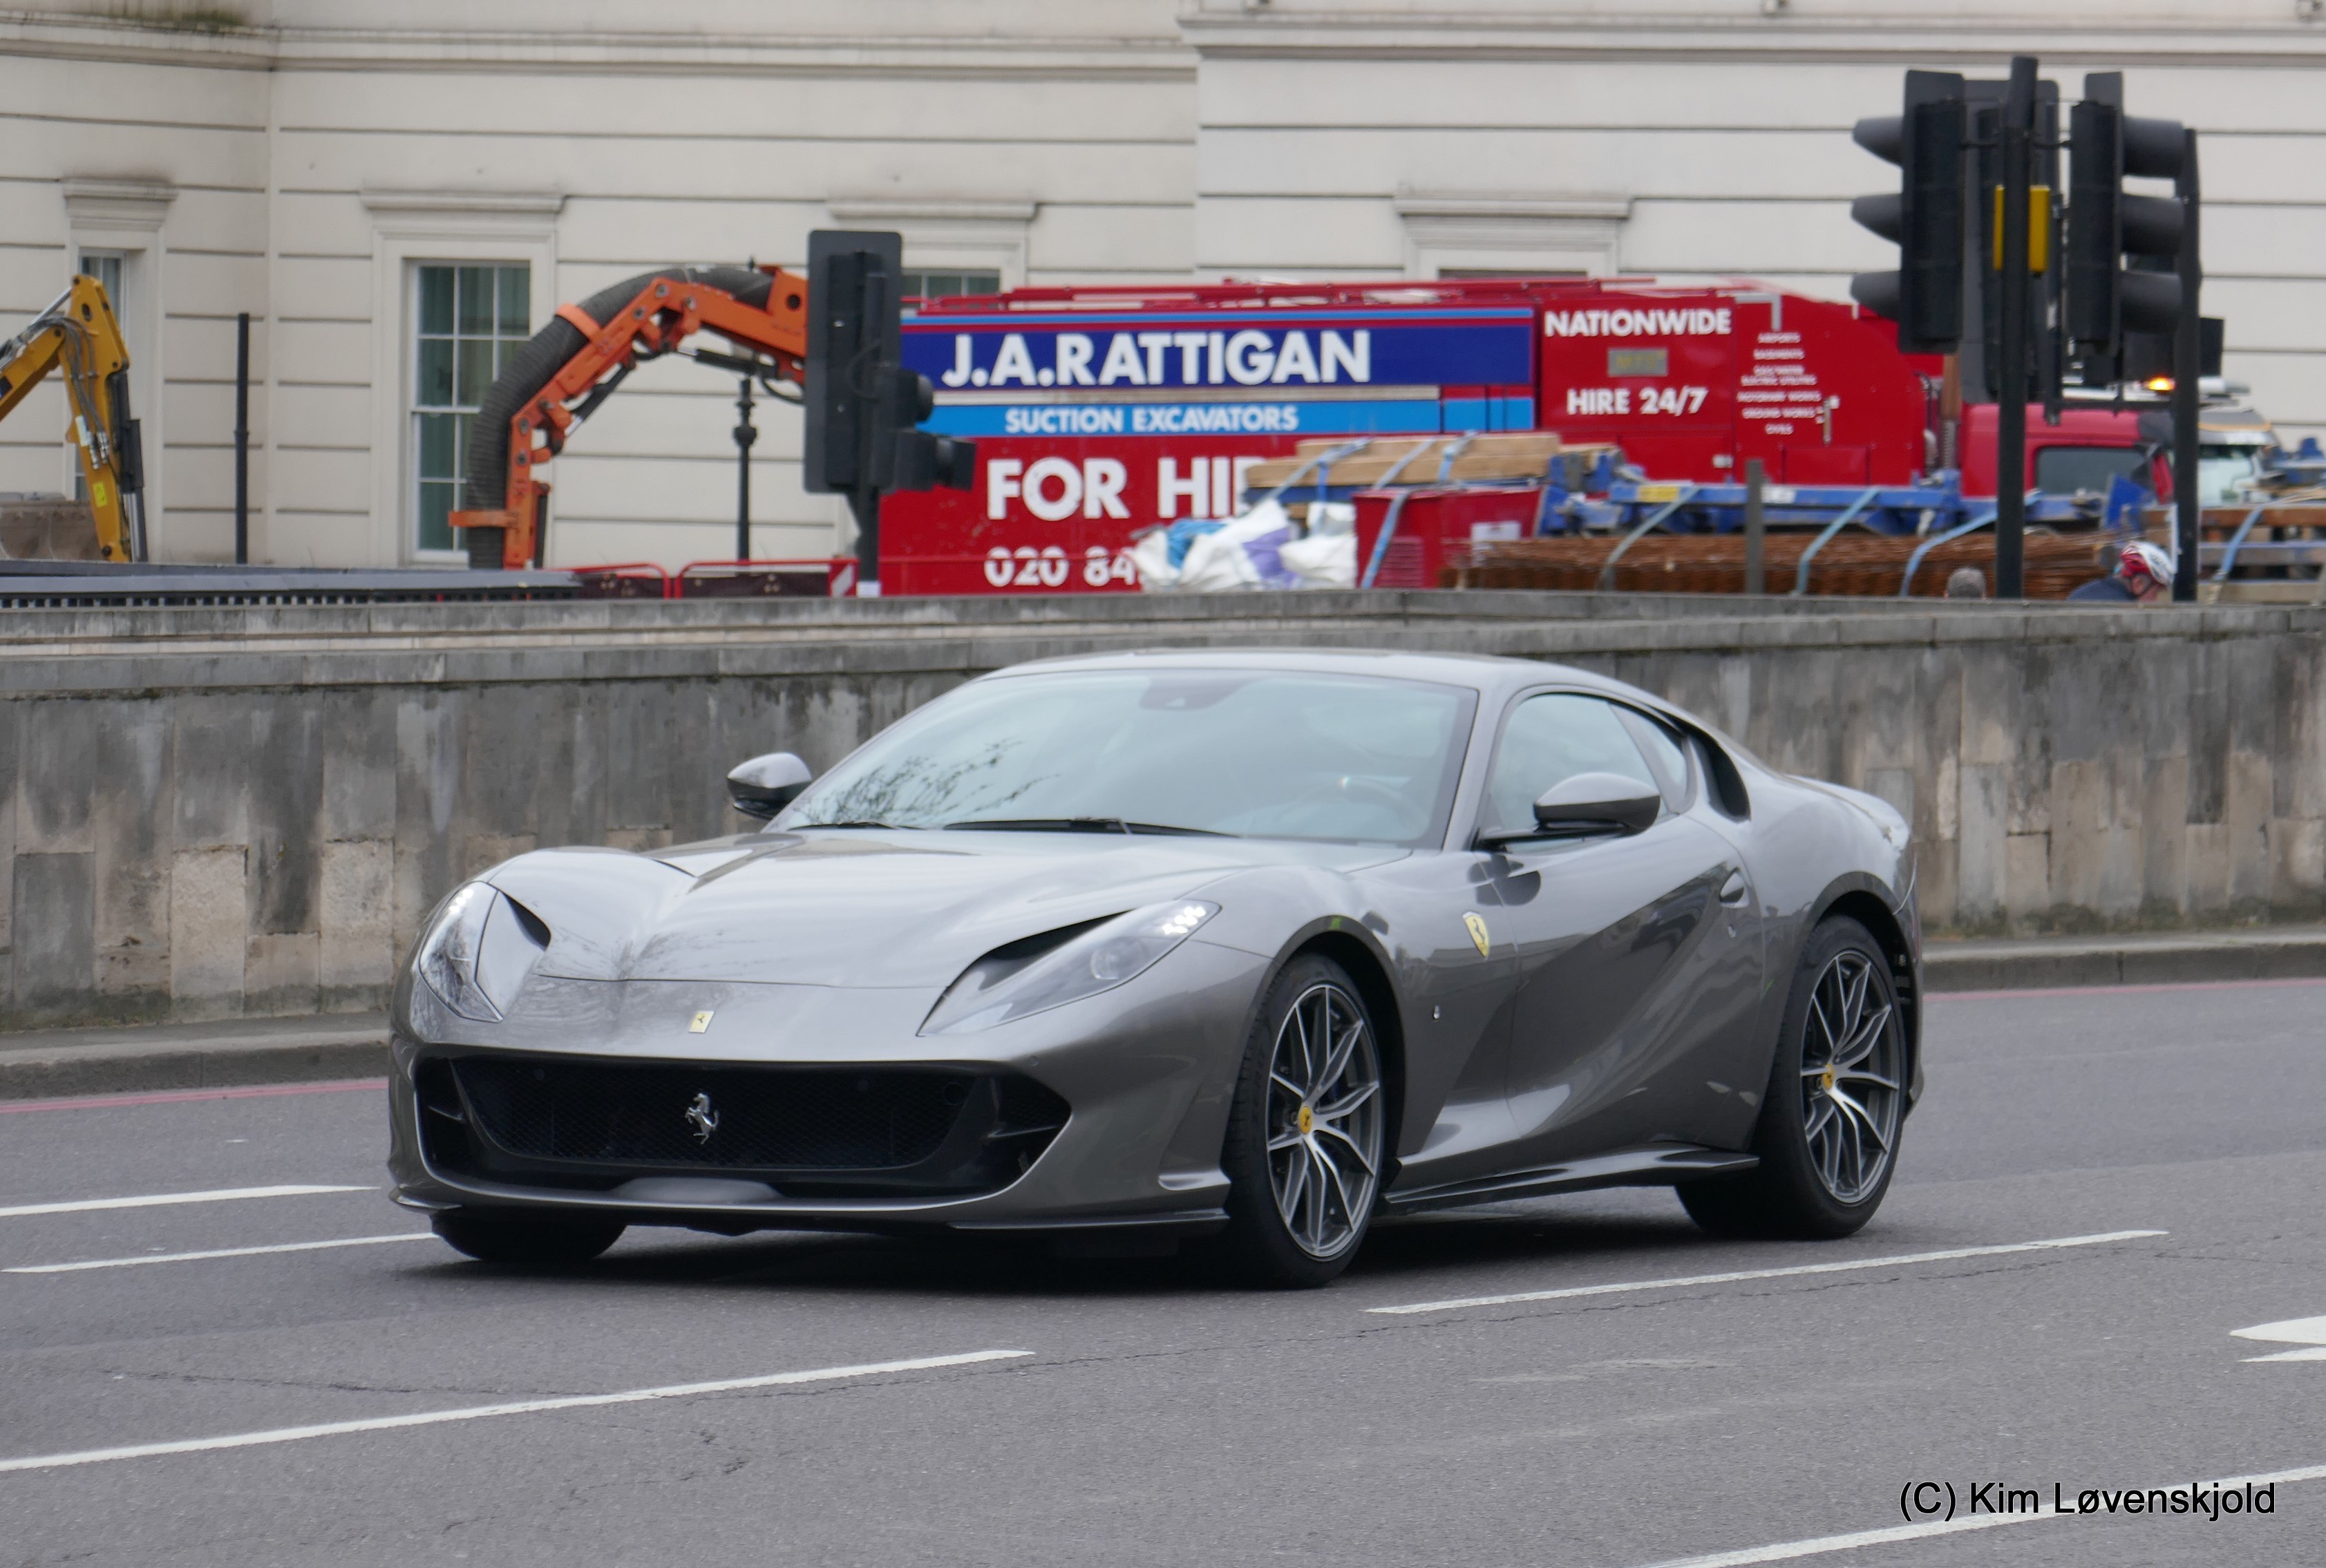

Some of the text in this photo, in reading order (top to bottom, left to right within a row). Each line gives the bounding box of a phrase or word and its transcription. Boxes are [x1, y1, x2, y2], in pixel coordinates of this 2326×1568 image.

[1544, 308, 1732, 337] NATIONWIDE
[941, 330, 1370, 387] J.A.RATTIGAN
[1567, 386, 1708, 417] HIRE 24/7
[1005, 406, 1298, 433] SUCTION EXCAVATORS
[987, 456, 1130, 520] FOR
[984, 547, 1069, 587] 020
